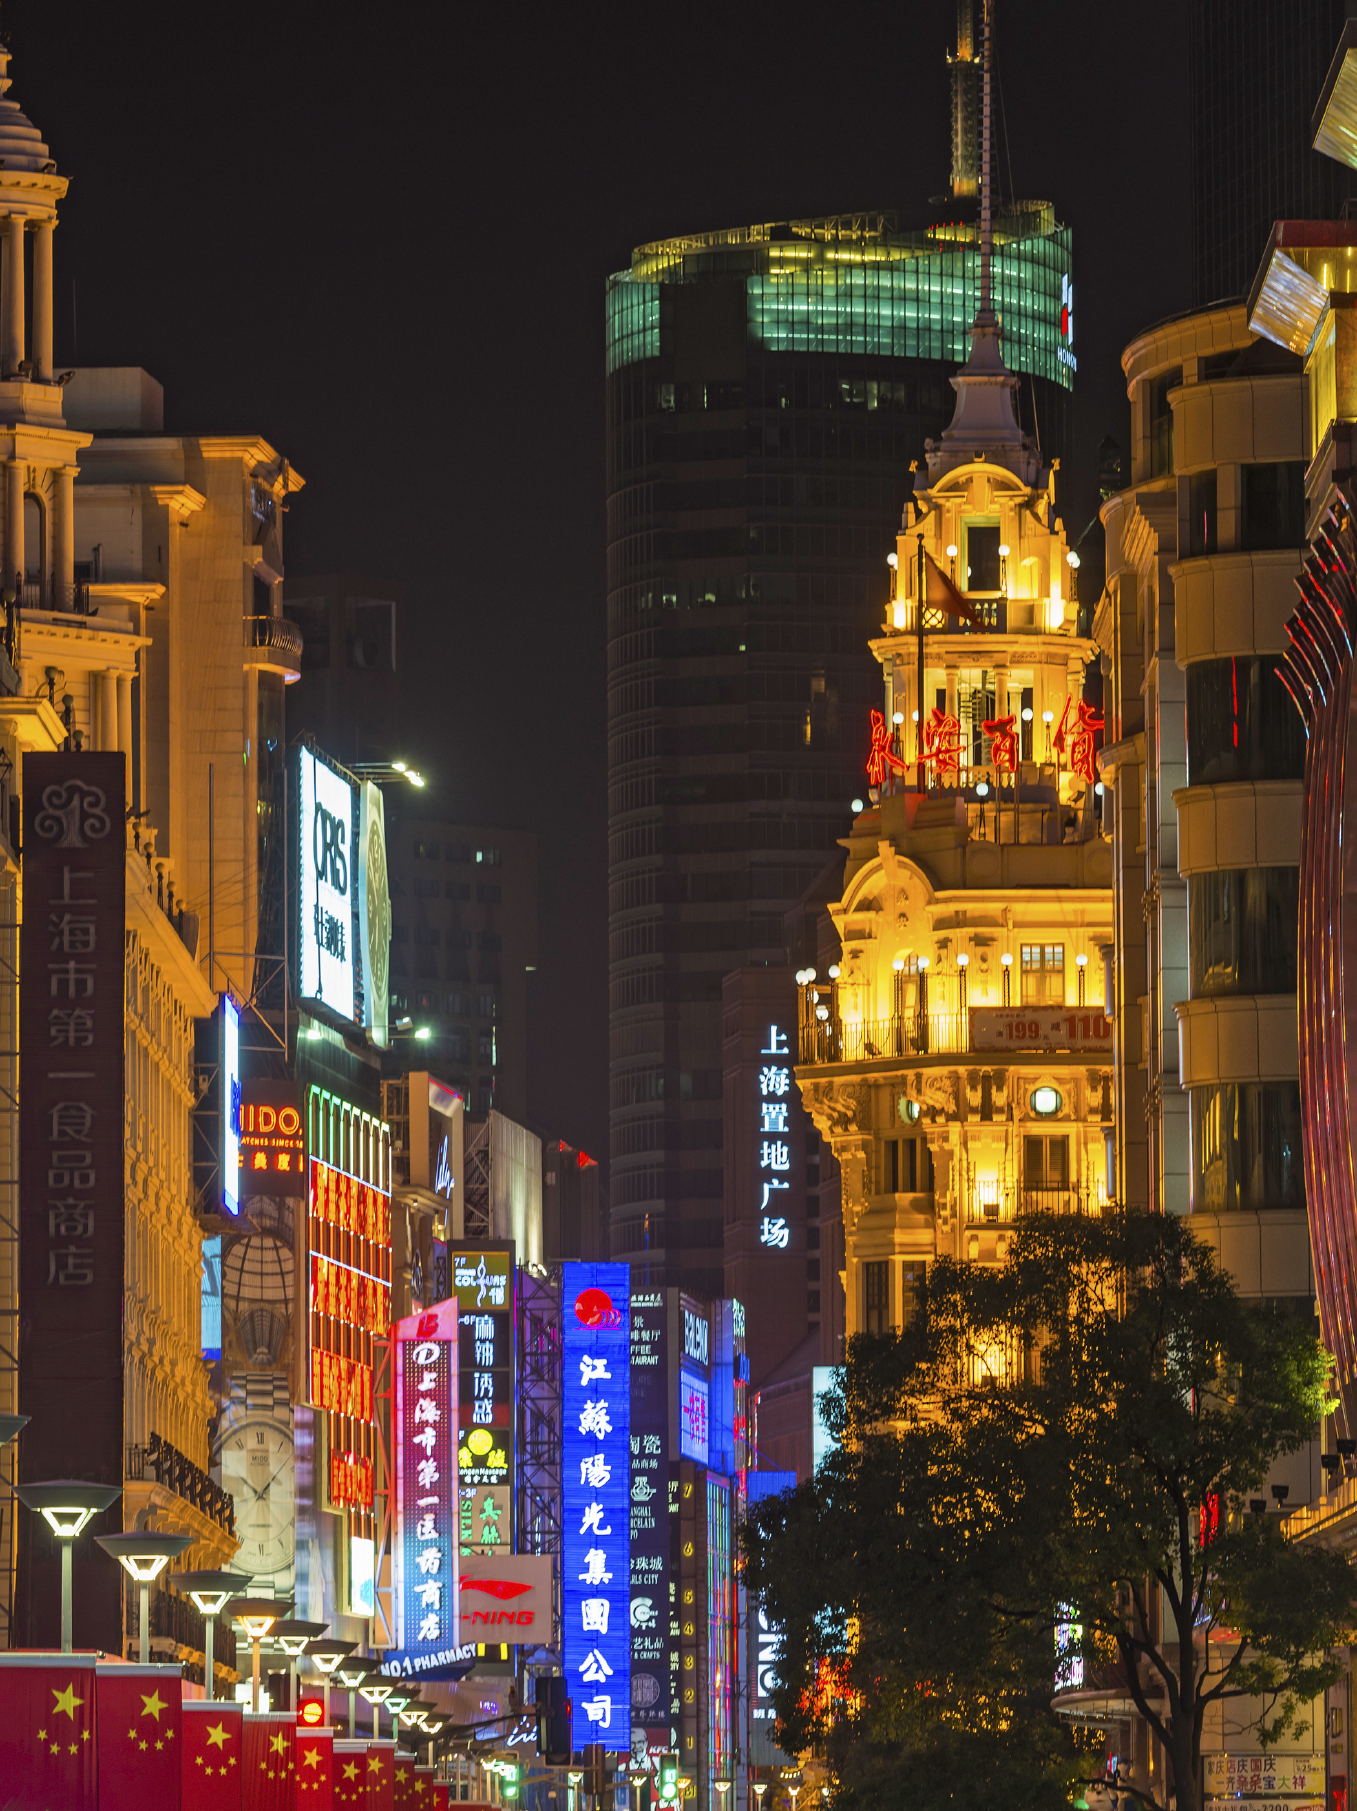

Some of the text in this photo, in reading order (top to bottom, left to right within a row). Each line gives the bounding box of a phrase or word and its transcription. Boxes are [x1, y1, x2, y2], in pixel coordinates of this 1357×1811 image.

[313, 801, 348, 897] ORIS
[47, 865, 98, 1287] 上海市第一食品商店
[759, 1024, 791, 1249] 上海置地广场
[412, 1369, 443, 1643] 上海市第一医药商店
[577, 1354, 615, 1730] 江蘇陽光集團公司
[413, 1642, 477, 1671] PHARMACY
[630, 1636, 664, 1650] 艺礼品
[648, 1745, 669, 1754] KFC
